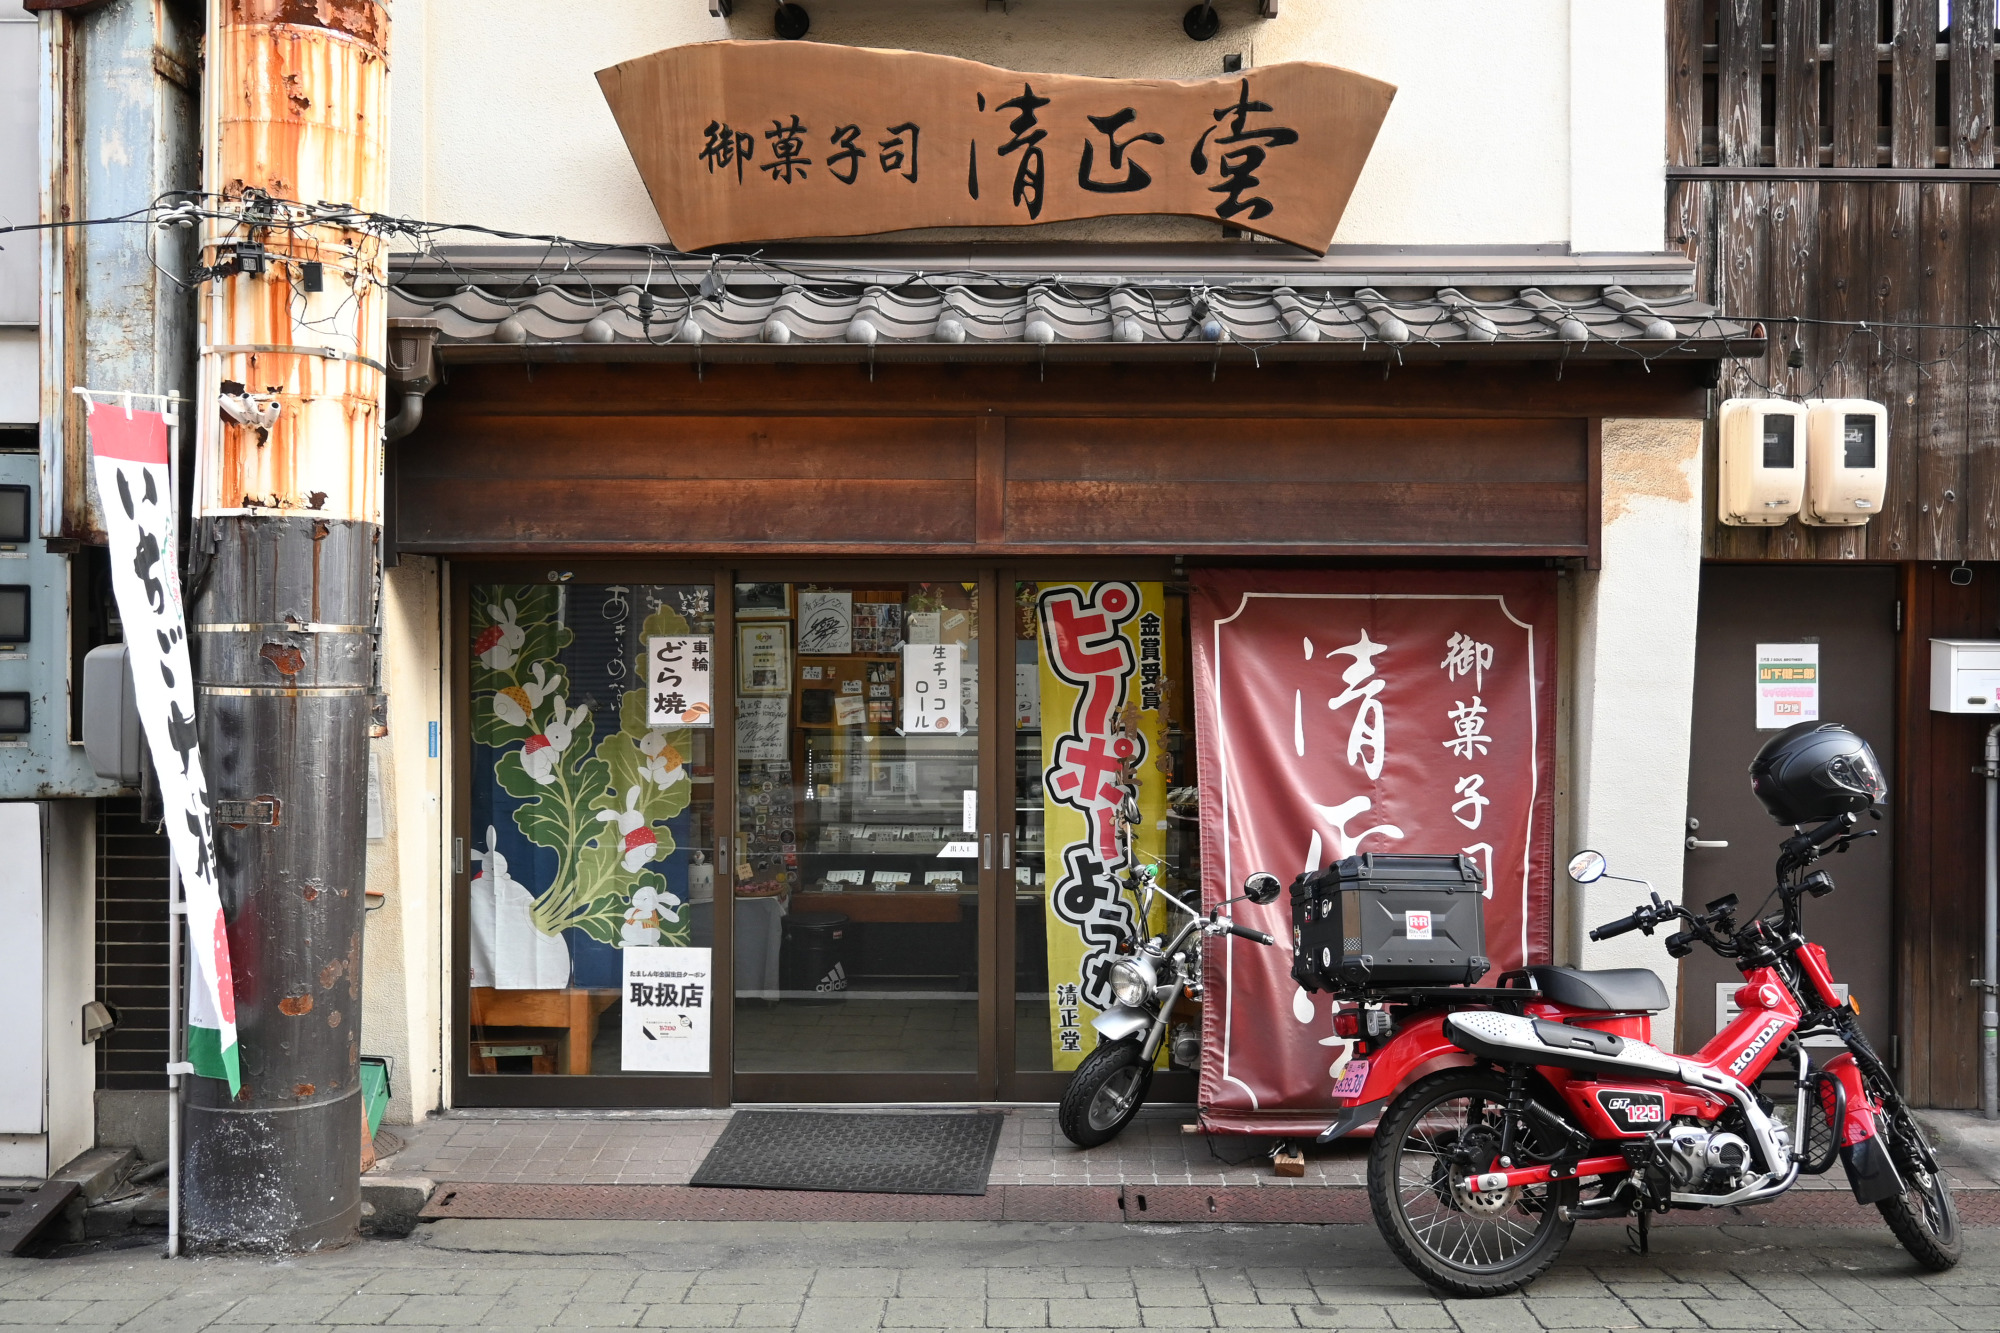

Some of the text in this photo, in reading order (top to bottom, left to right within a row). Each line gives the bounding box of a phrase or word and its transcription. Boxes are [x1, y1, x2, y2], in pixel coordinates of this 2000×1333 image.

[698, 78, 1299, 221] 御菓子司 清正堂
[654, 640, 687, 714] どら焼
[692, 640, 709, 672] 車輪
[932, 645, 948, 711] 生チョコ
[1139, 611, 1161, 711] 金賞受賞
[915, 680, 930, 728] ロール
[1037, 580, 1148, 1046] ピーポーようか
[630, 982, 704, 1008] 取扱店
[1056, 983, 1082, 1052] 清正堂
[1728, 1018, 1786, 1076] HONDA
[1609, 1098, 1661, 1123] CT 125
